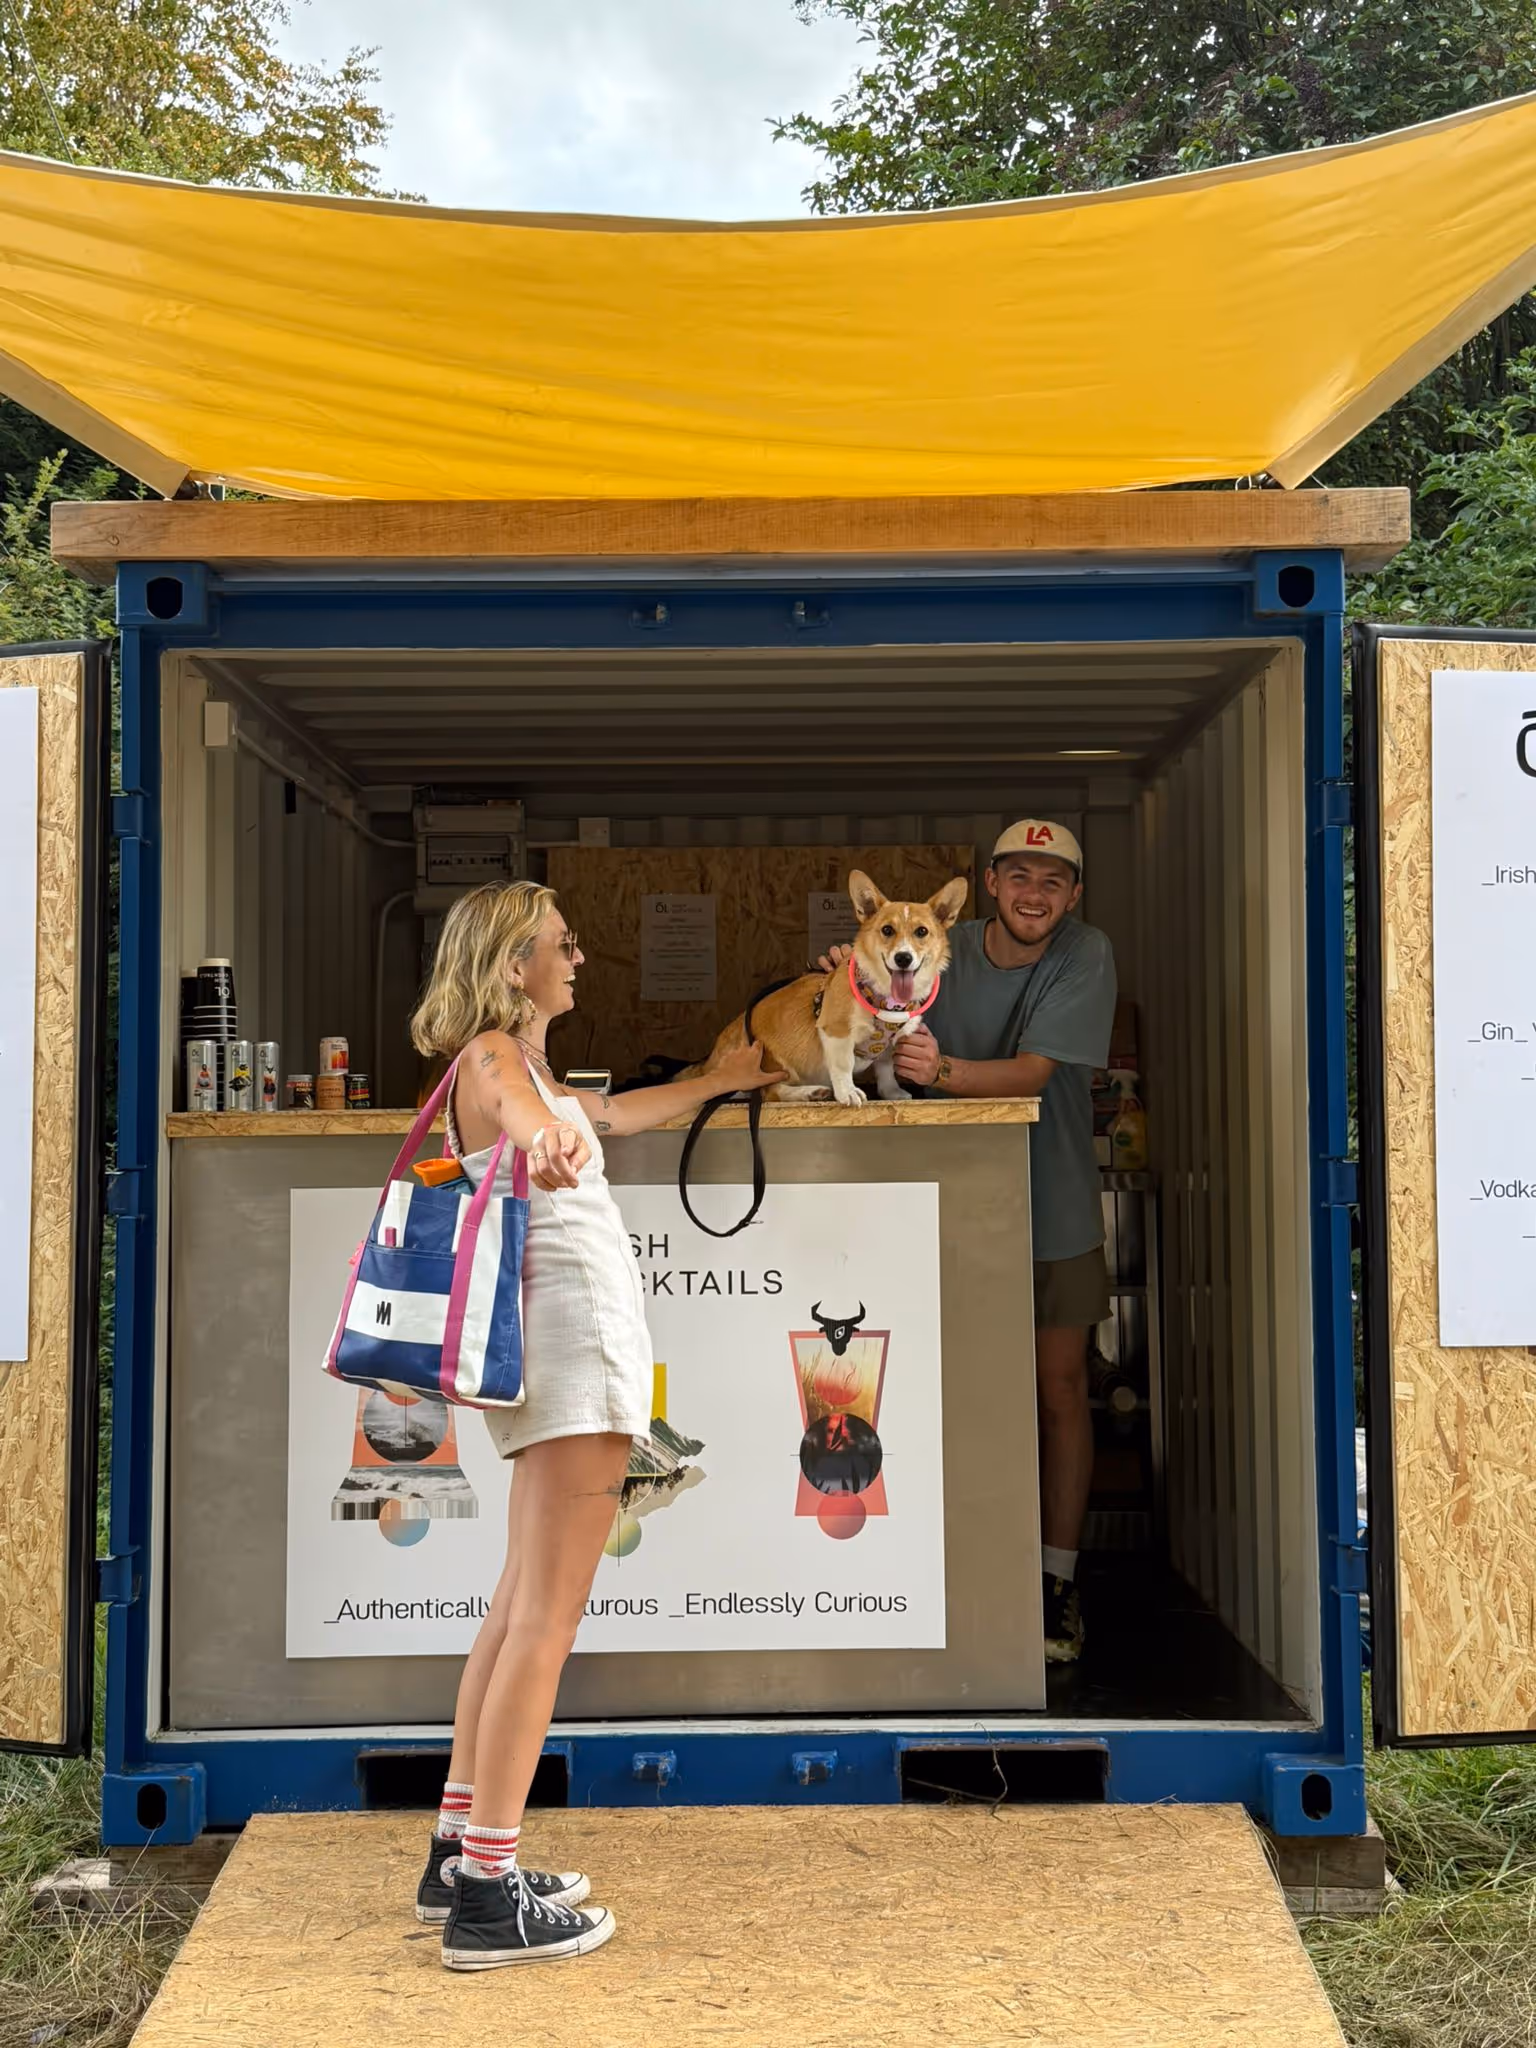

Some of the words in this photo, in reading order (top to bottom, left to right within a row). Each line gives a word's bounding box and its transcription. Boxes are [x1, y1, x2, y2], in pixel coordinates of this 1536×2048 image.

[1026, 825, 1054, 846] LA
[629, 1233, 669, 1258] SH
[323, 1596, 490, 1624] _Authenticall
[814, 1590, 908, 1614] Curious
